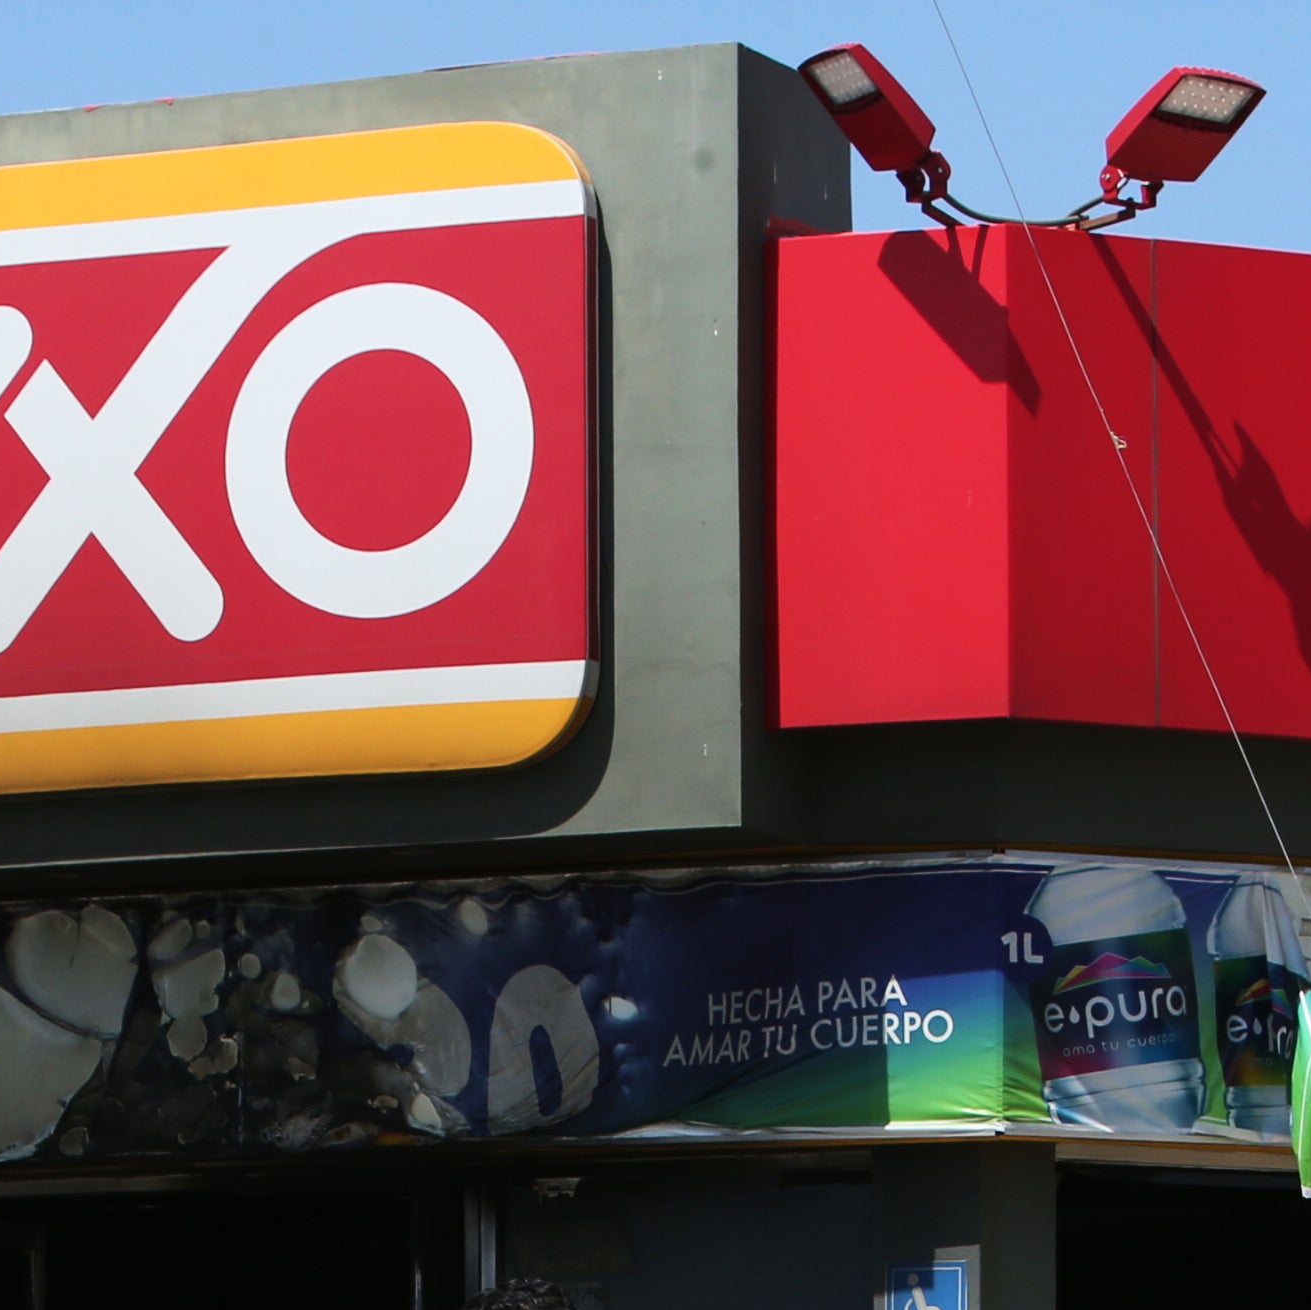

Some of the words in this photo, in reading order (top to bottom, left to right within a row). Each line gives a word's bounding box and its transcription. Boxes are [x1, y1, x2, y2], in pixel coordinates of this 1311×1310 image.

[1000, 931, 1044, 964] 1L
[707, 983, 806, 1026] HECHA
[818, 974, 908, 1013] PARA
[663, 1030, 752, 1067] AMAR
[761, 1024, 798, 1058] TU
[810, 1009, 954, 1050] CUERPO
[1062, 1044, 1096, 1058] ama
[1101, 1039, 1119, 1051] tu
[1126, 1032, 1177, 1049] cuerpo
